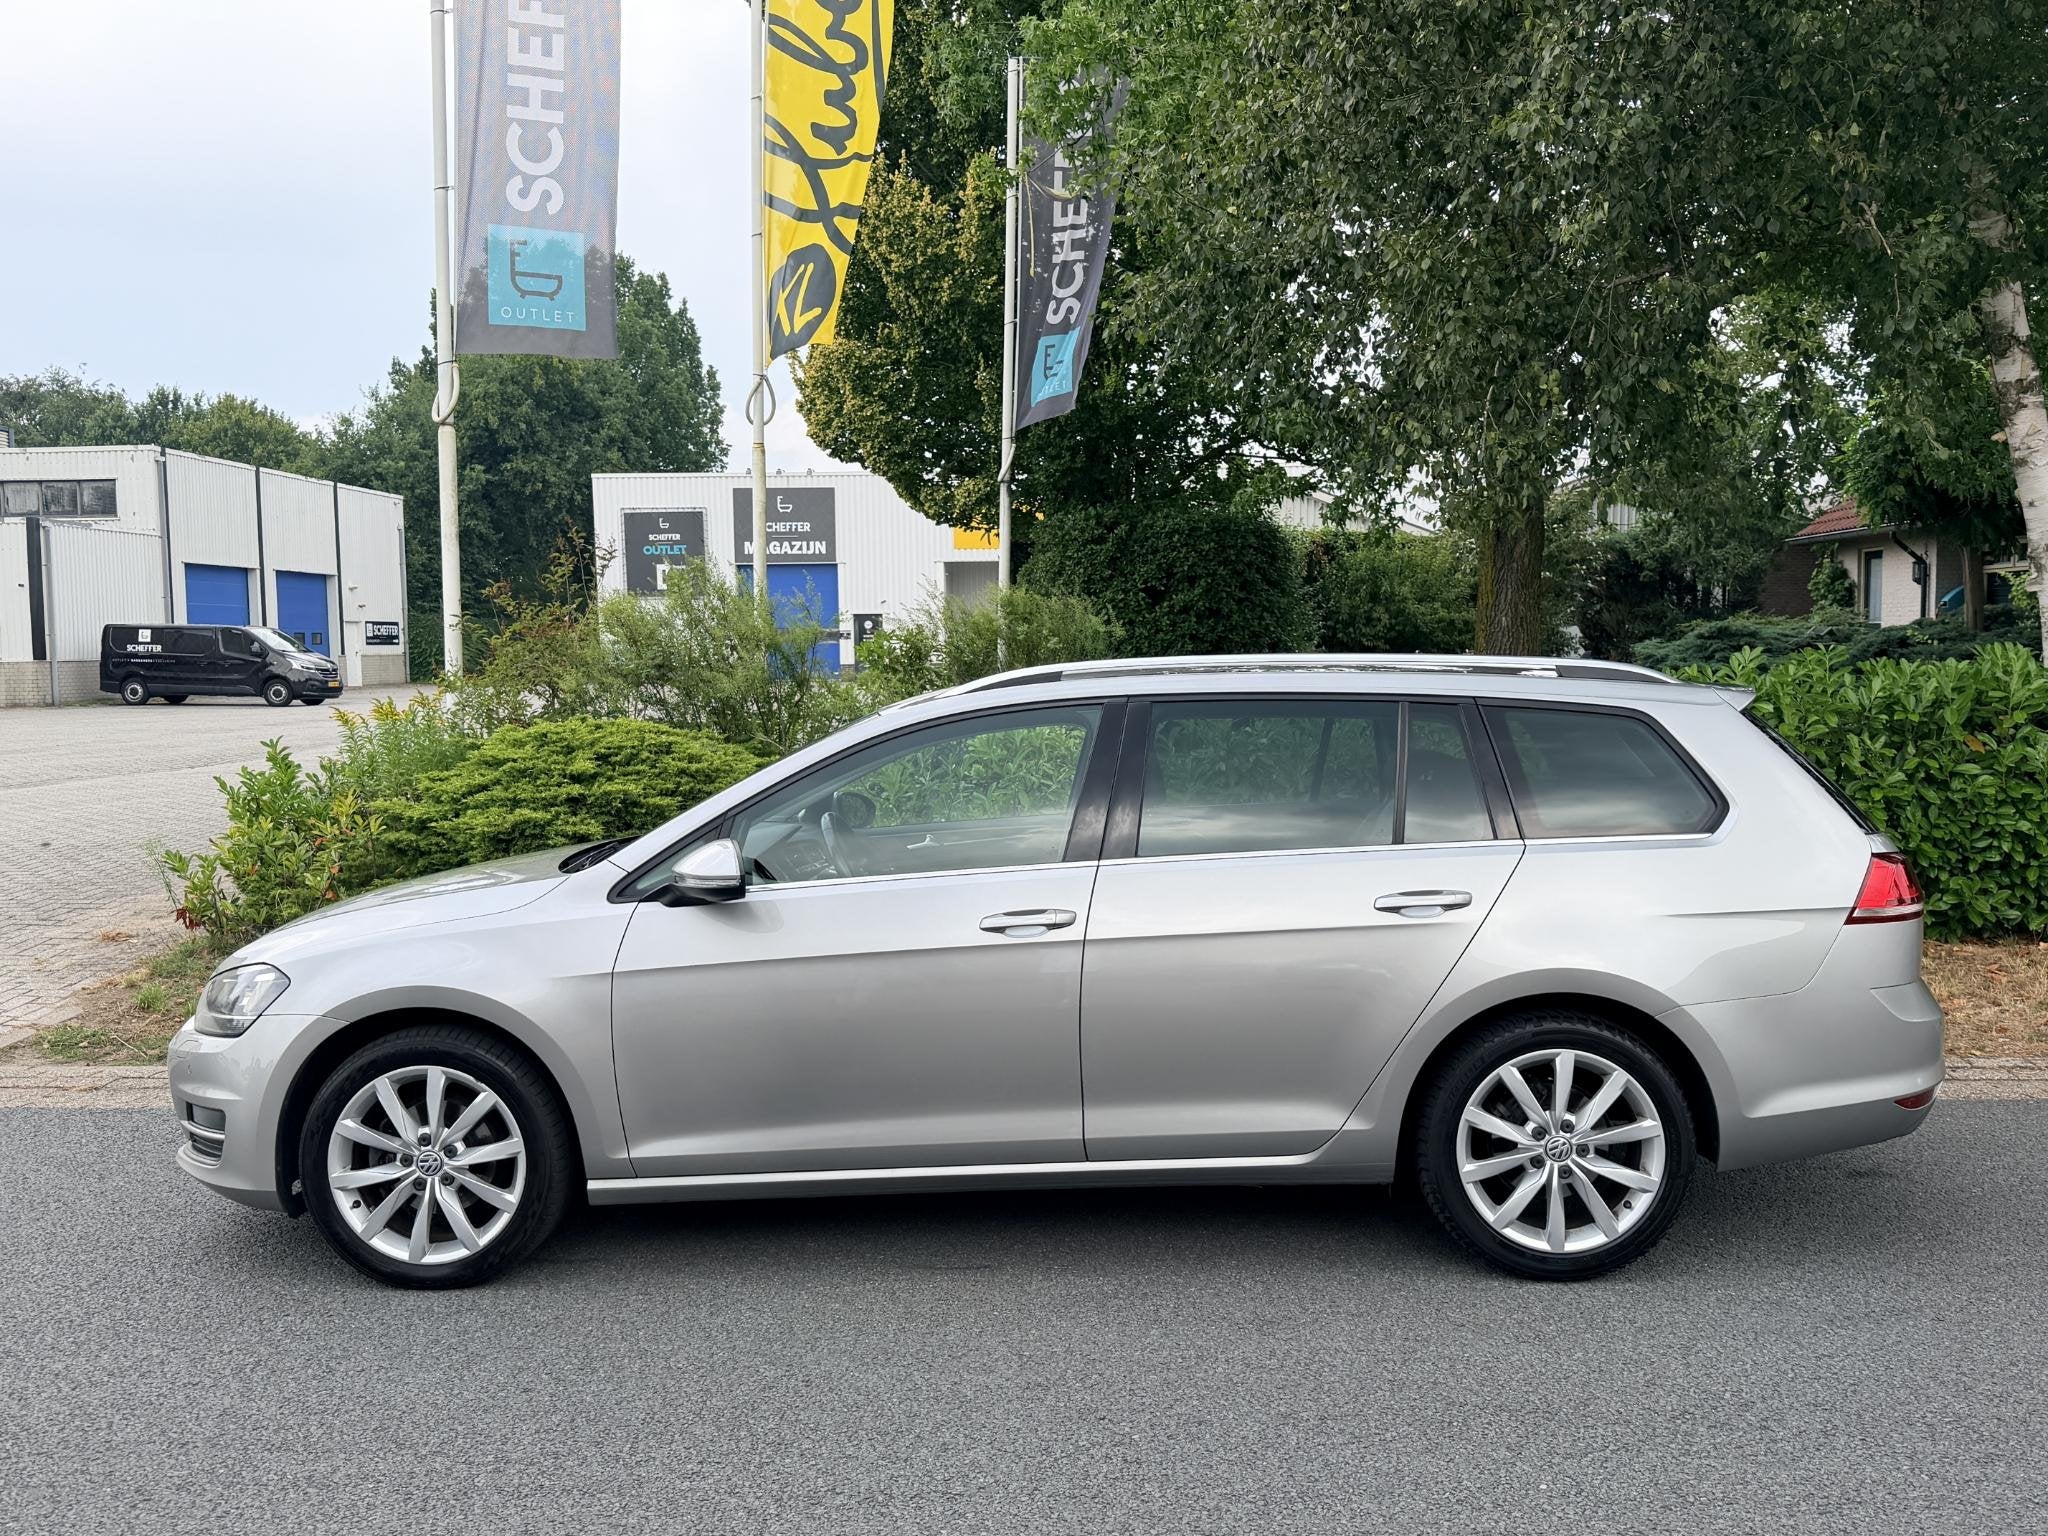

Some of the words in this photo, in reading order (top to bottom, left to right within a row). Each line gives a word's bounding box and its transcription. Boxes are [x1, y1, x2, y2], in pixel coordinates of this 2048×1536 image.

[500, 306, 576, 324] OUTLET
[766, 521, 811, 532] CHEFFER
[648, 533, 681, 541] SCHEFFER
[643, 544, 687, 555] OUTLET
[743, 540, 827, 555] MGAZIJN
[373, 624, 399, 636] SCHEFFER
[126, 644, 162, 653] SCHEFFER
